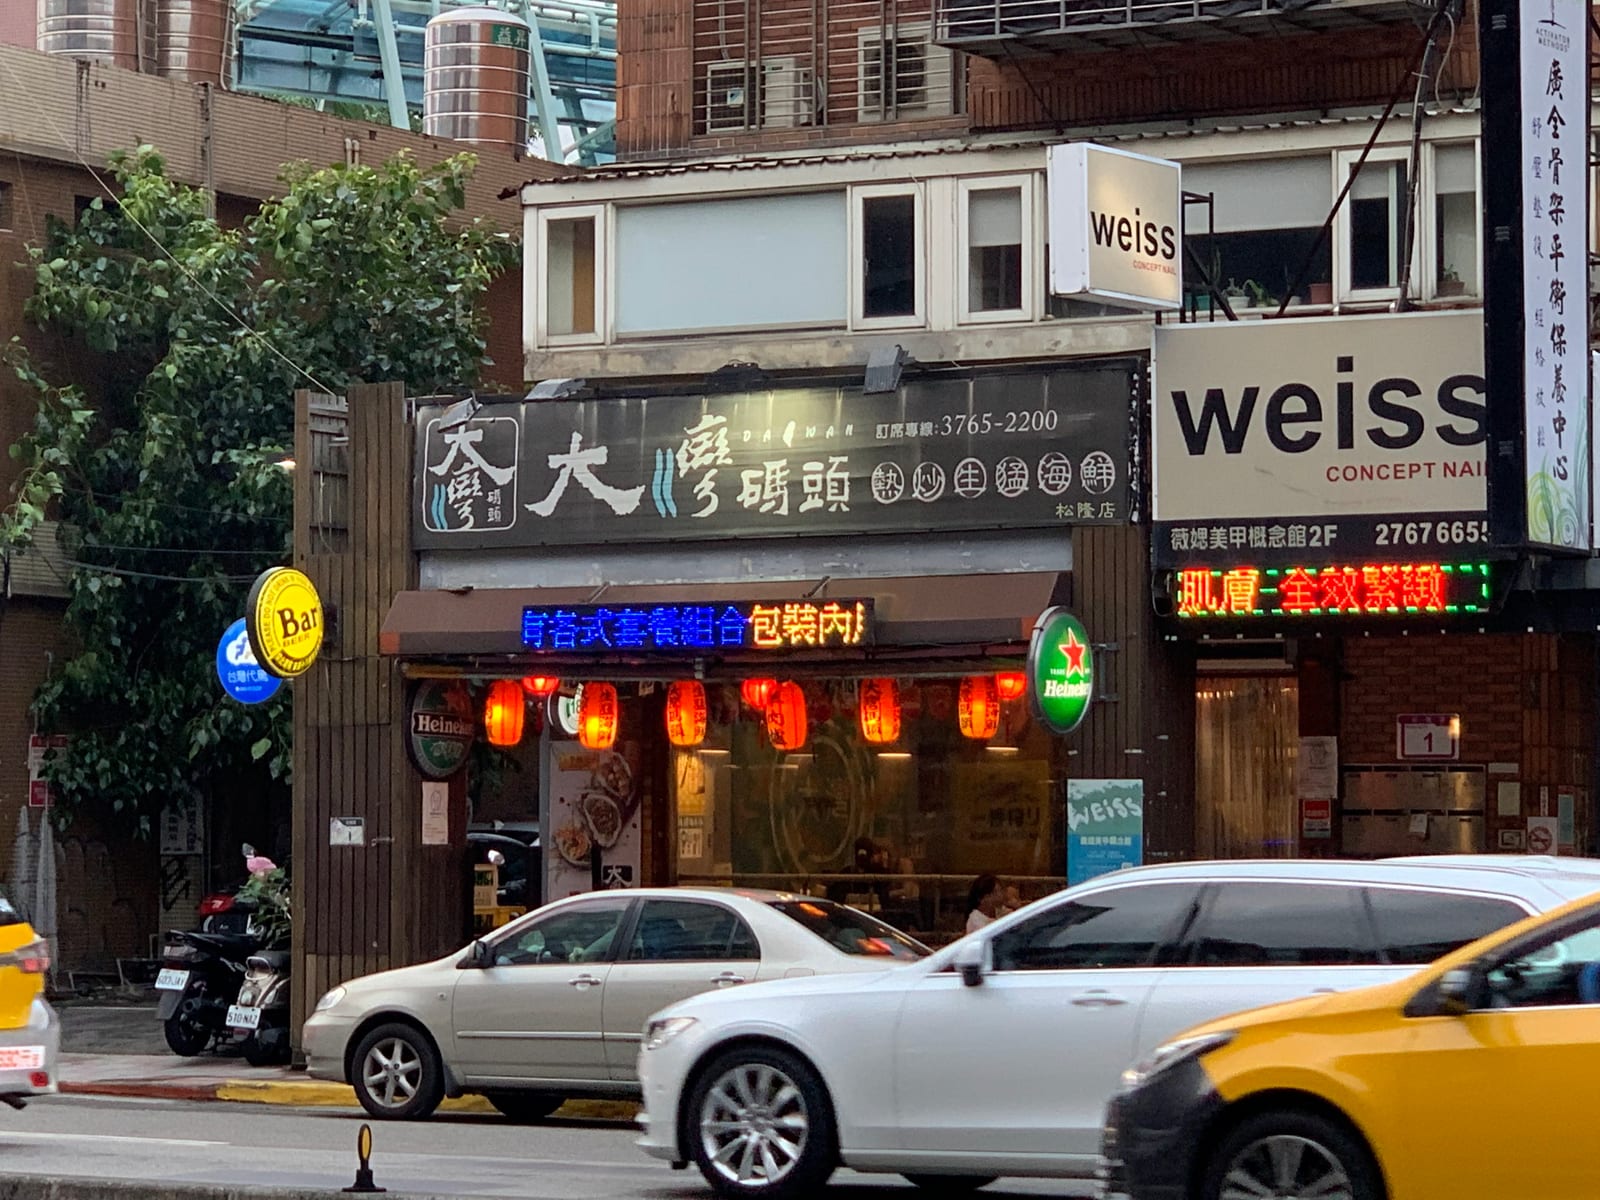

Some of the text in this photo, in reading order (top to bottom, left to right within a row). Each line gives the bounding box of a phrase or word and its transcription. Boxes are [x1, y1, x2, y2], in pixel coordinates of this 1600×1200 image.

[1091, 207, 1175, 260] weiss
[1133, 259, 1161, 271] CONCEPT
[1171, 356, 1487, 455] weiss
[871, 451, 1116, 504] 熱炒生猛海鮮
[1326, 460, 1487, 482] CONCEPT NAI
[1055, 502, 1117, 520] 松隆店
[277, 607, 318, 640] Bar
[1423, 731, 1433, 752] 1
